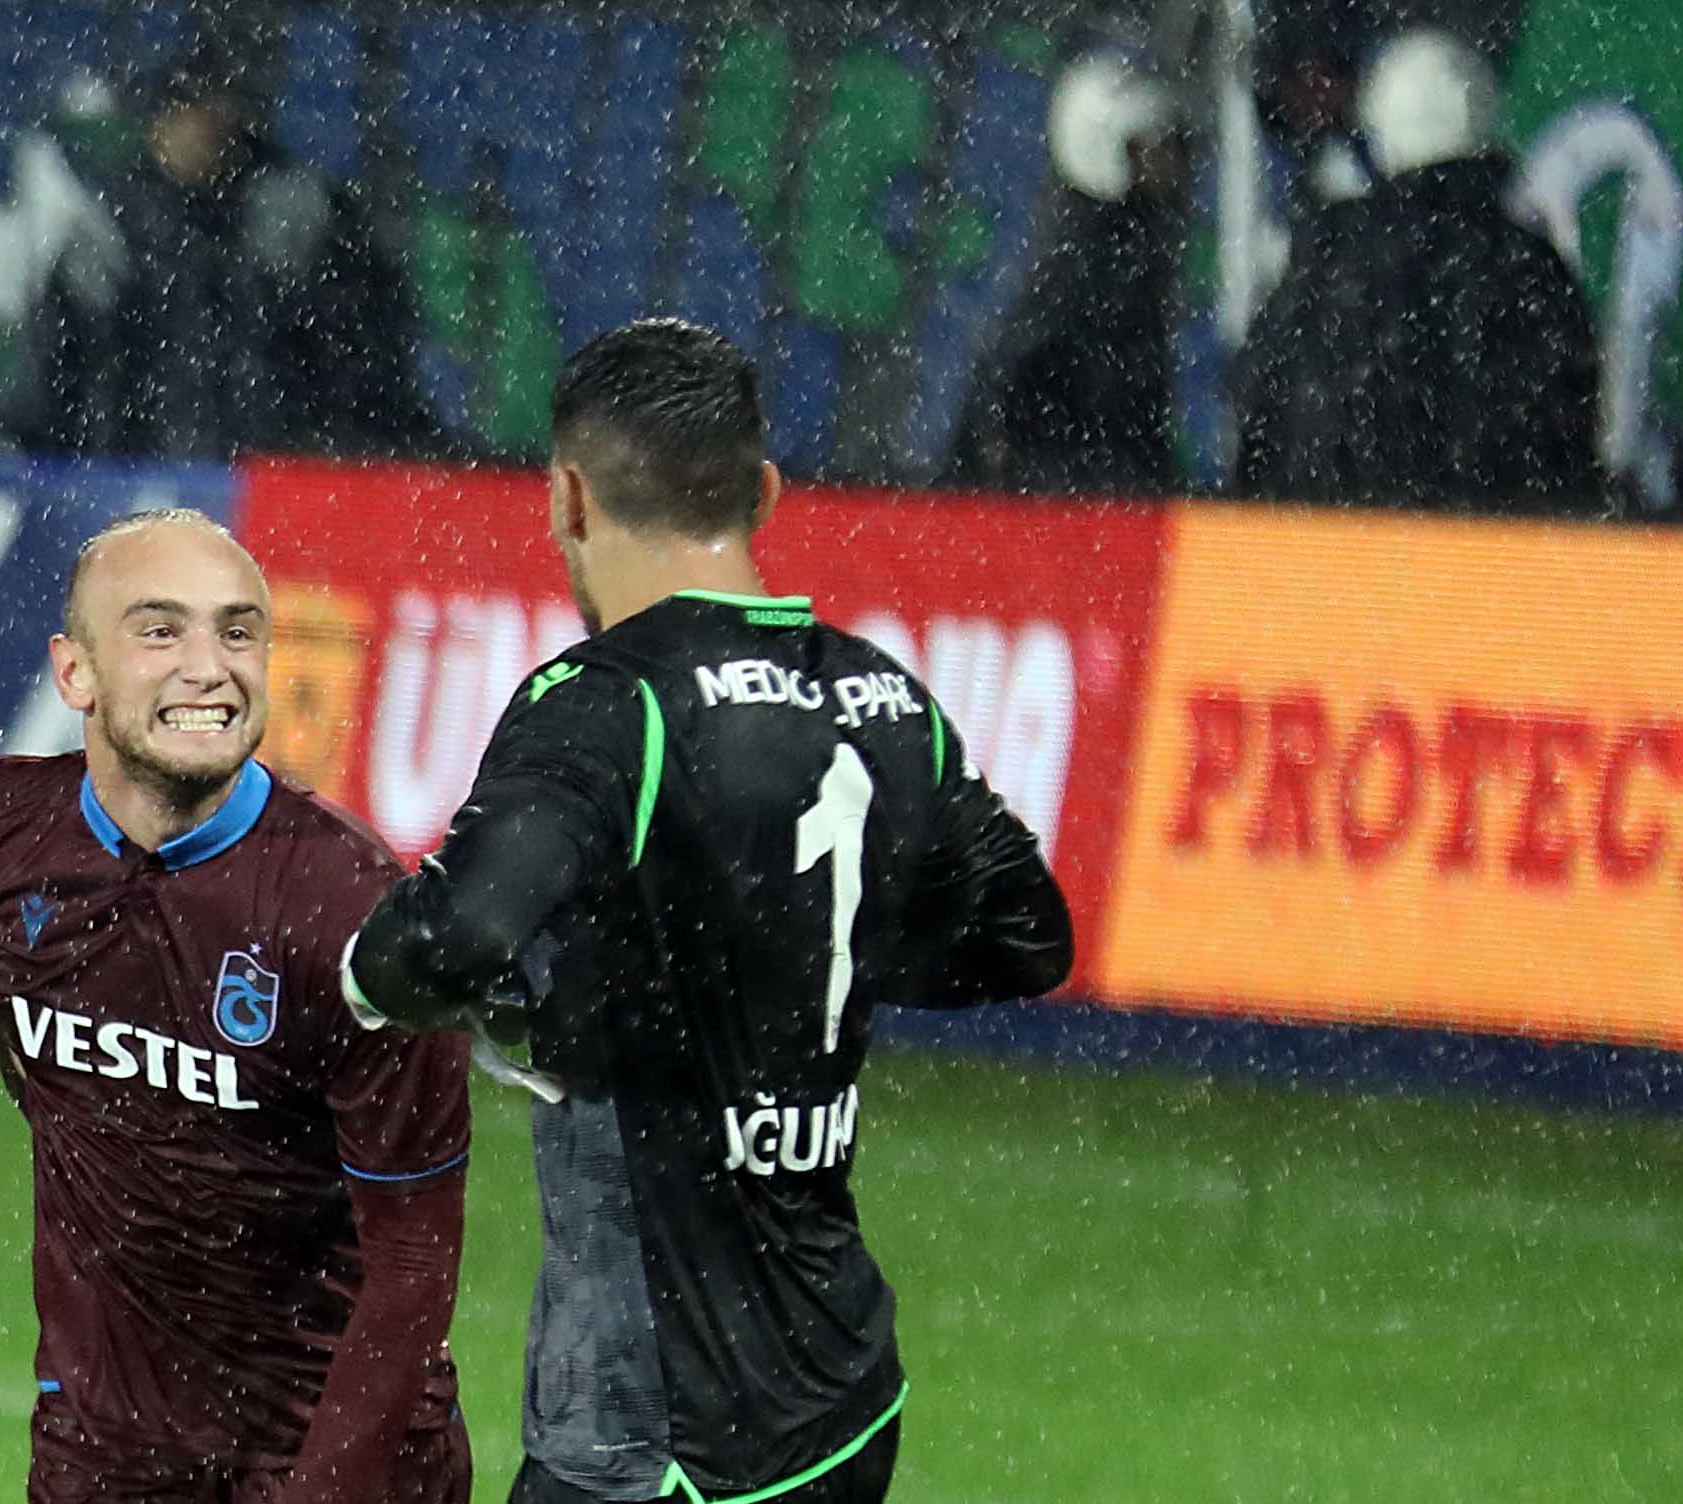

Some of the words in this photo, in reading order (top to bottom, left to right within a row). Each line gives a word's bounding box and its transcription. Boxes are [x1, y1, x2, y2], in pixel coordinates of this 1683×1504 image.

[1166, 684, 1682, 888] PROTEC
[795, 742, 874, 1053] 1
[11, 995, 260, 1111] VESTEL
